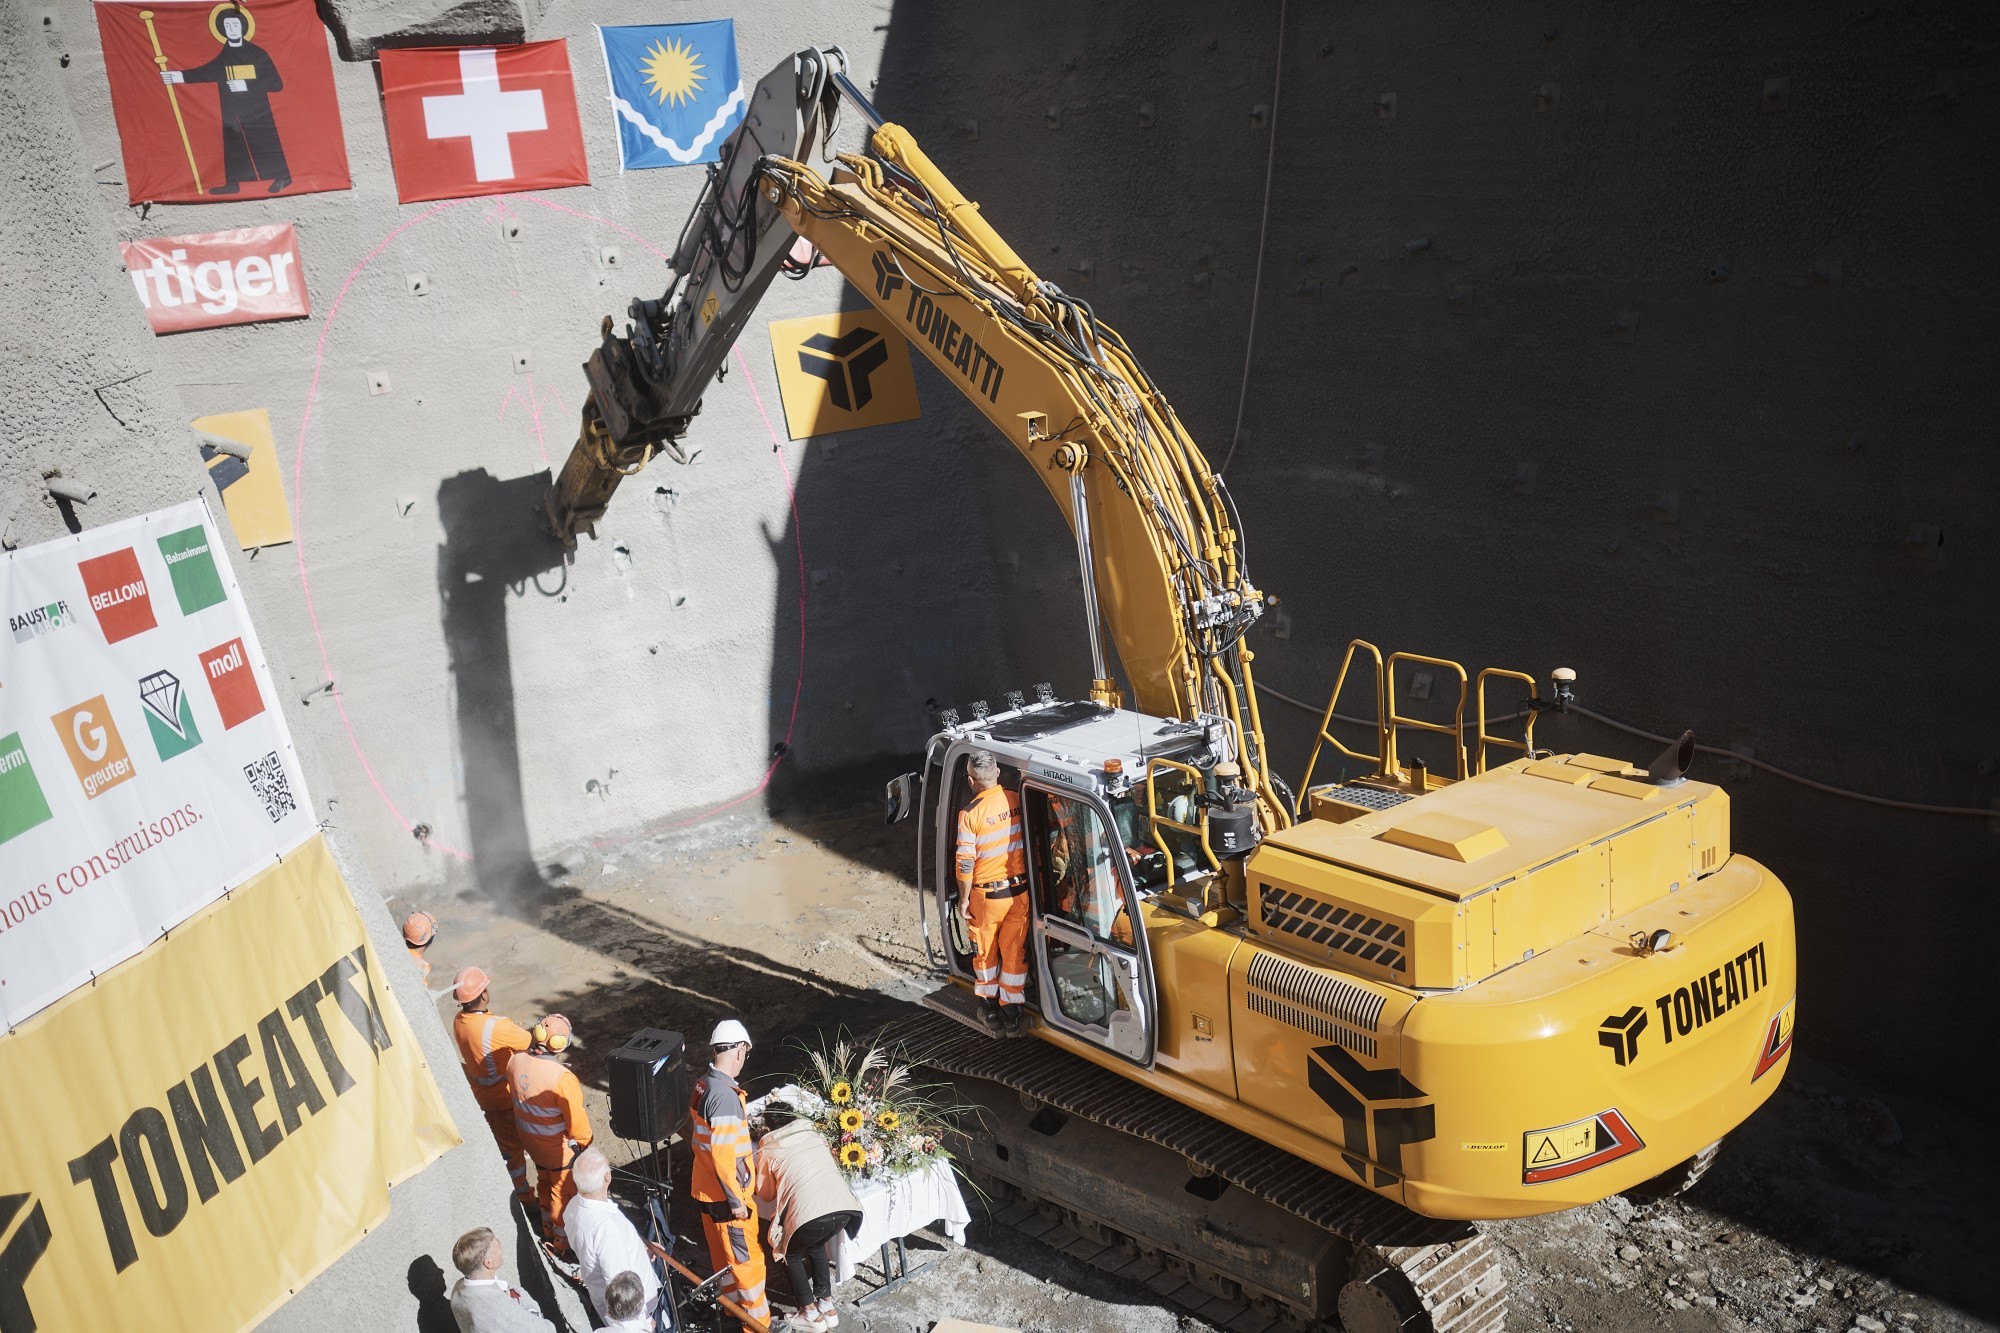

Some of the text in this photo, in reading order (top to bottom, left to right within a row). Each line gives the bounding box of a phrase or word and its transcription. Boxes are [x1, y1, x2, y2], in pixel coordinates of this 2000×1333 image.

[906, 283, 1004, 404] TONEATTI
[91, 580, 147, 611] BELLONI
[208, 642, 243, 679] moll
[73, 710, 108, 762] G
[0, 749, 26, 776] erm
[83, 756, 130, 796] greuter
[1043, 768, 1073, 784] HITACHI
[56, 803, 204, 896] construisons.
[1655, 941, 1768, 1045] TONEATTI
